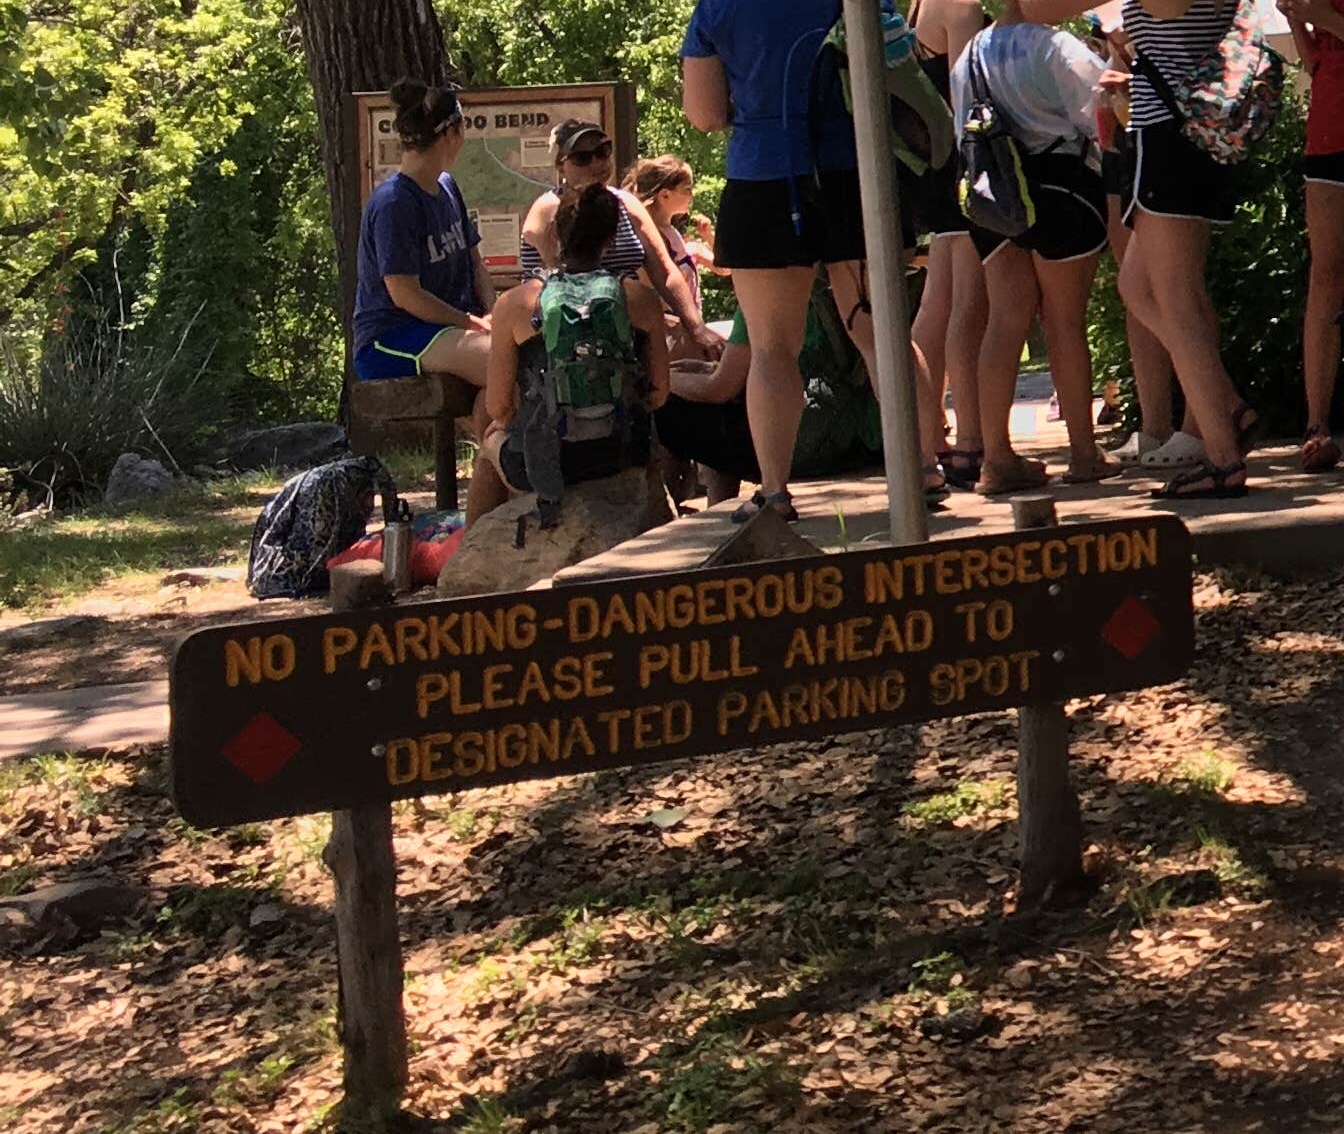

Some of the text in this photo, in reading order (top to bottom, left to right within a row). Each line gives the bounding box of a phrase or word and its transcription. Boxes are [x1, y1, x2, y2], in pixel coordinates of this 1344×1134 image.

[495, 112, 550, 129] BEND
[224, 633, 297, 688] NO
[865, 528, 1158, 605] INTERSECTION
[416, 599, 1015, 719] PLEASE PULL AHEAD TO
[385, 650, 1041, 786] DESIGNATED PARKING SPOT
